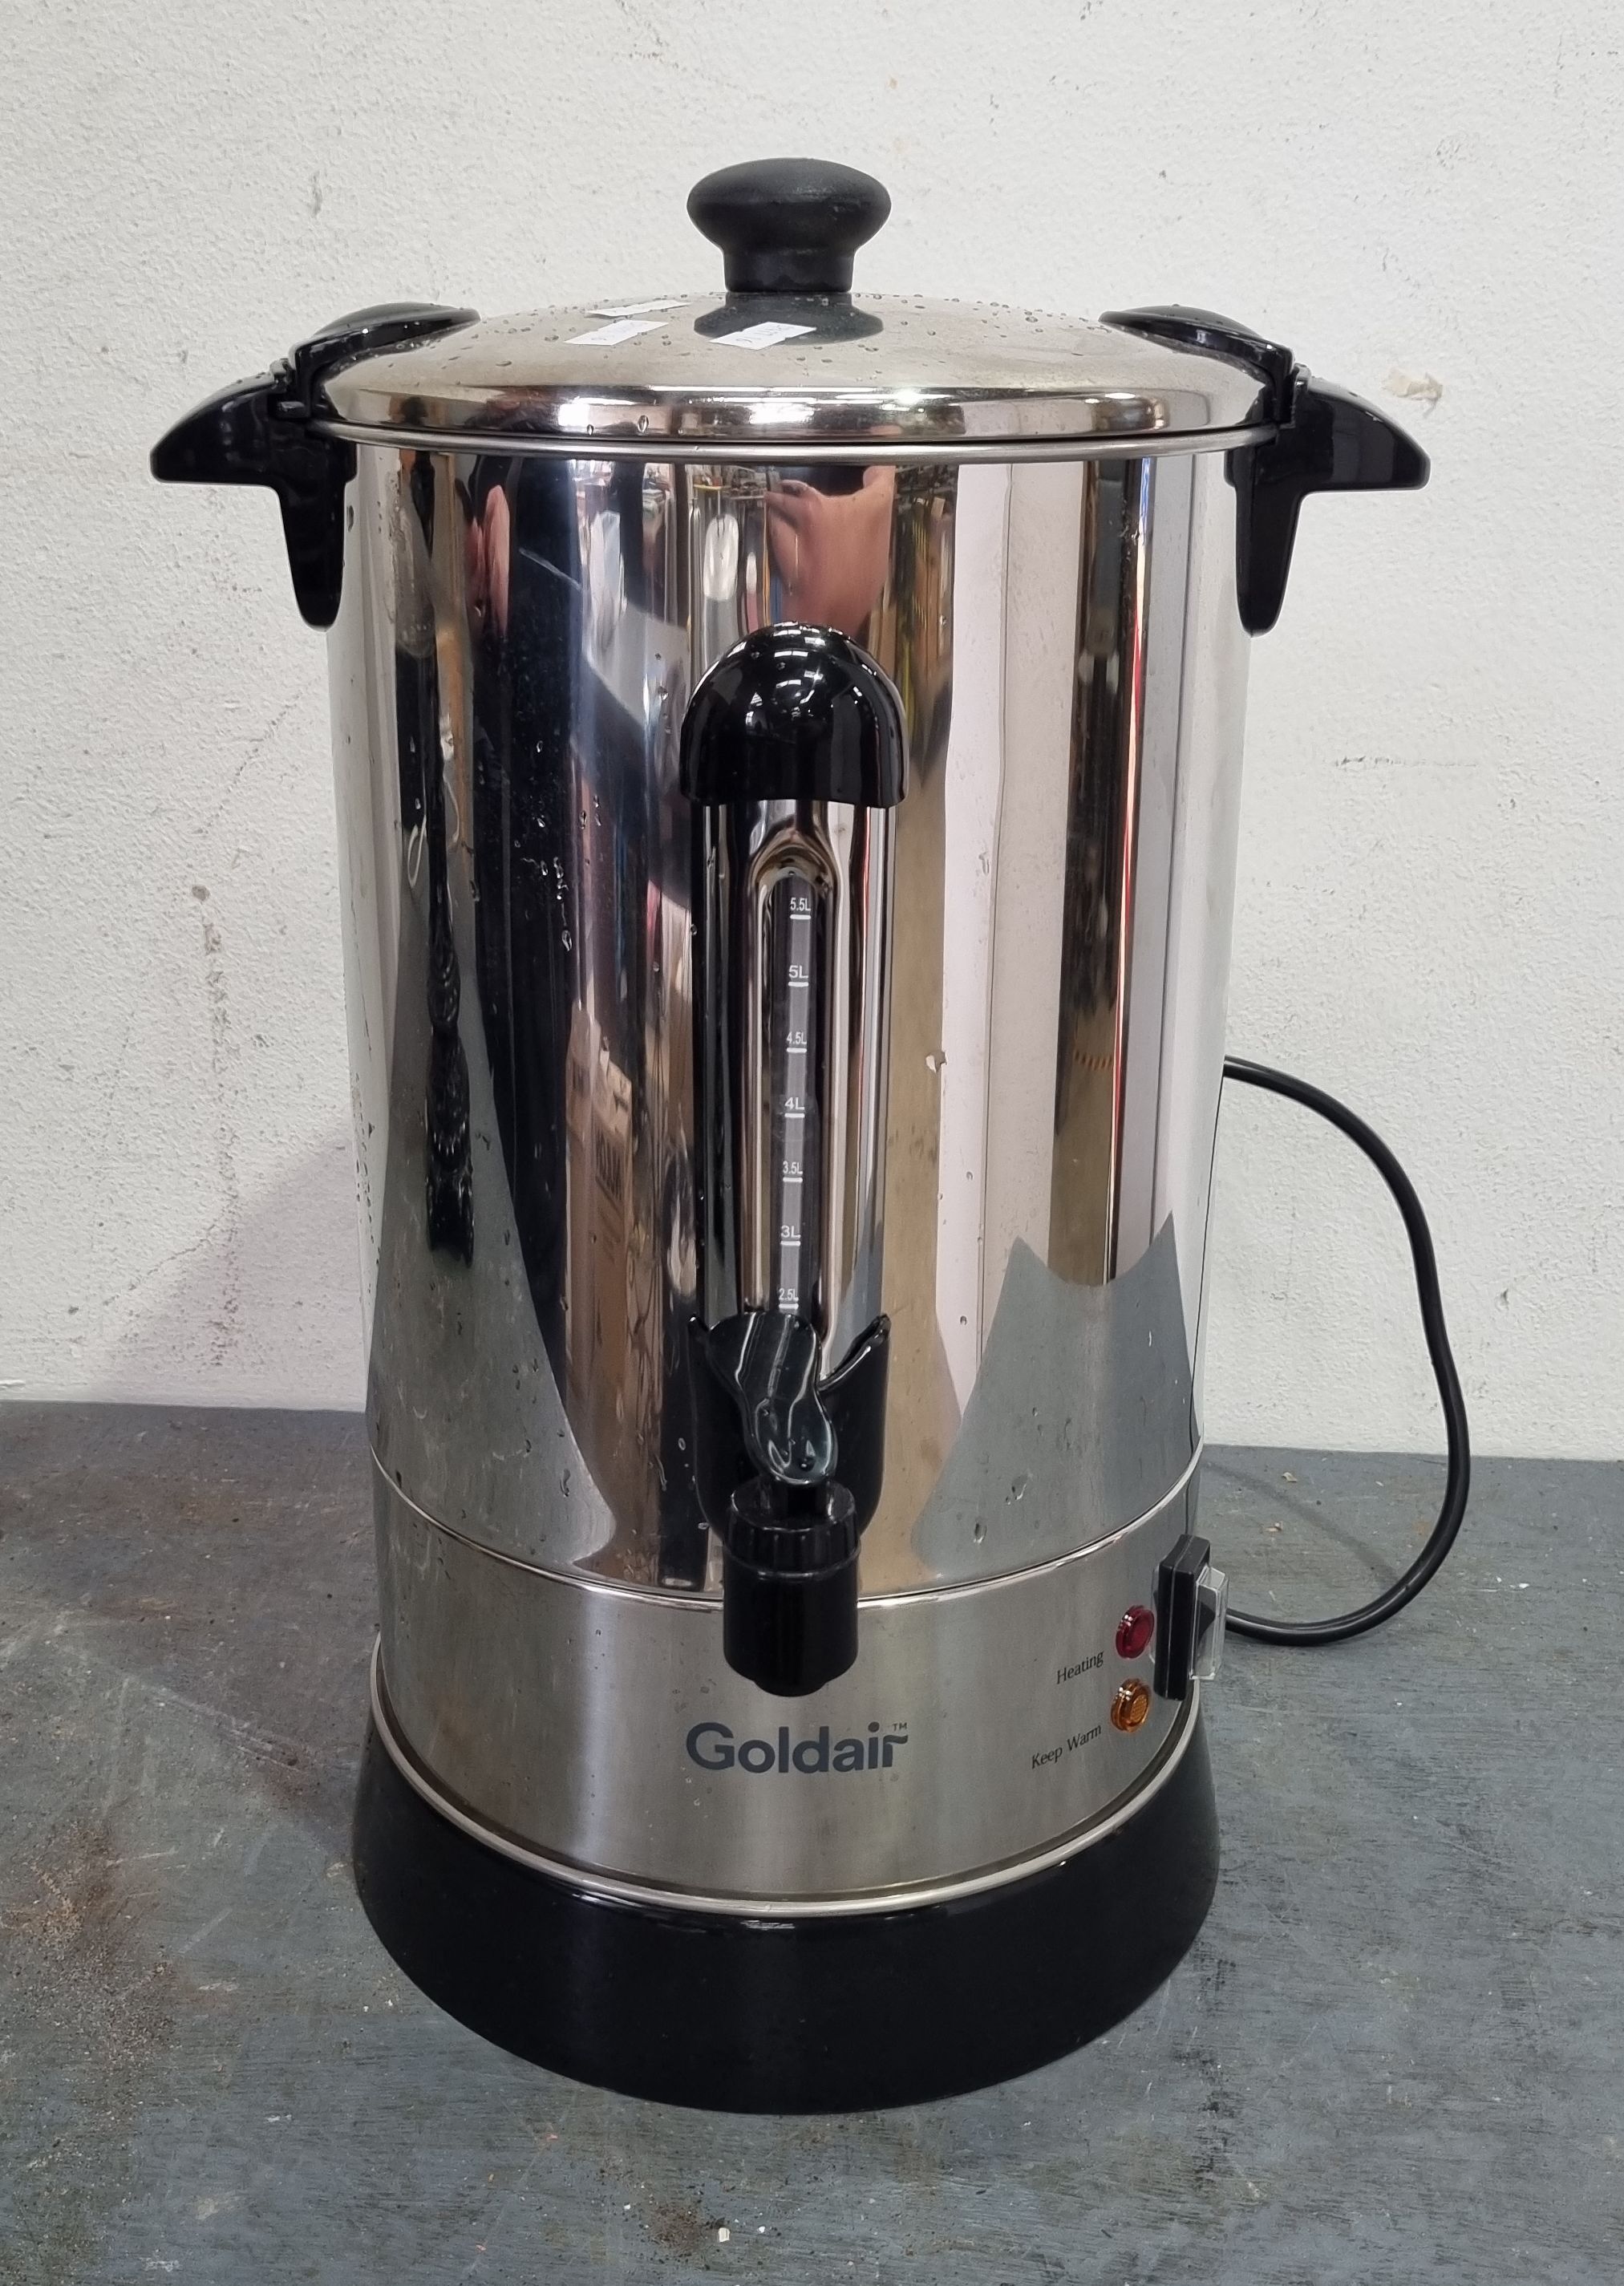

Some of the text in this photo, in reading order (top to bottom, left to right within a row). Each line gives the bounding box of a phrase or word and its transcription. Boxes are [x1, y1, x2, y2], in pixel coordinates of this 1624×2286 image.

[790, 898, 812, 911] 5.5L
[788, 965, 809, 979] 5L
[787, 1032, 808, 1044] 4.5L
[784, 1096, 805, 1110] 4L
[783, 1161, 803, 1175] 3.5L
[780, 1226, 801, 1238] 3L
[779, 1288, 799, 1302] 2.5L
[1056, 1651, 1104, 1684] Heating
[686, 1721, 909, 1773] Goldair
[1031, 1725, 1102, 1769] Keep Warm
